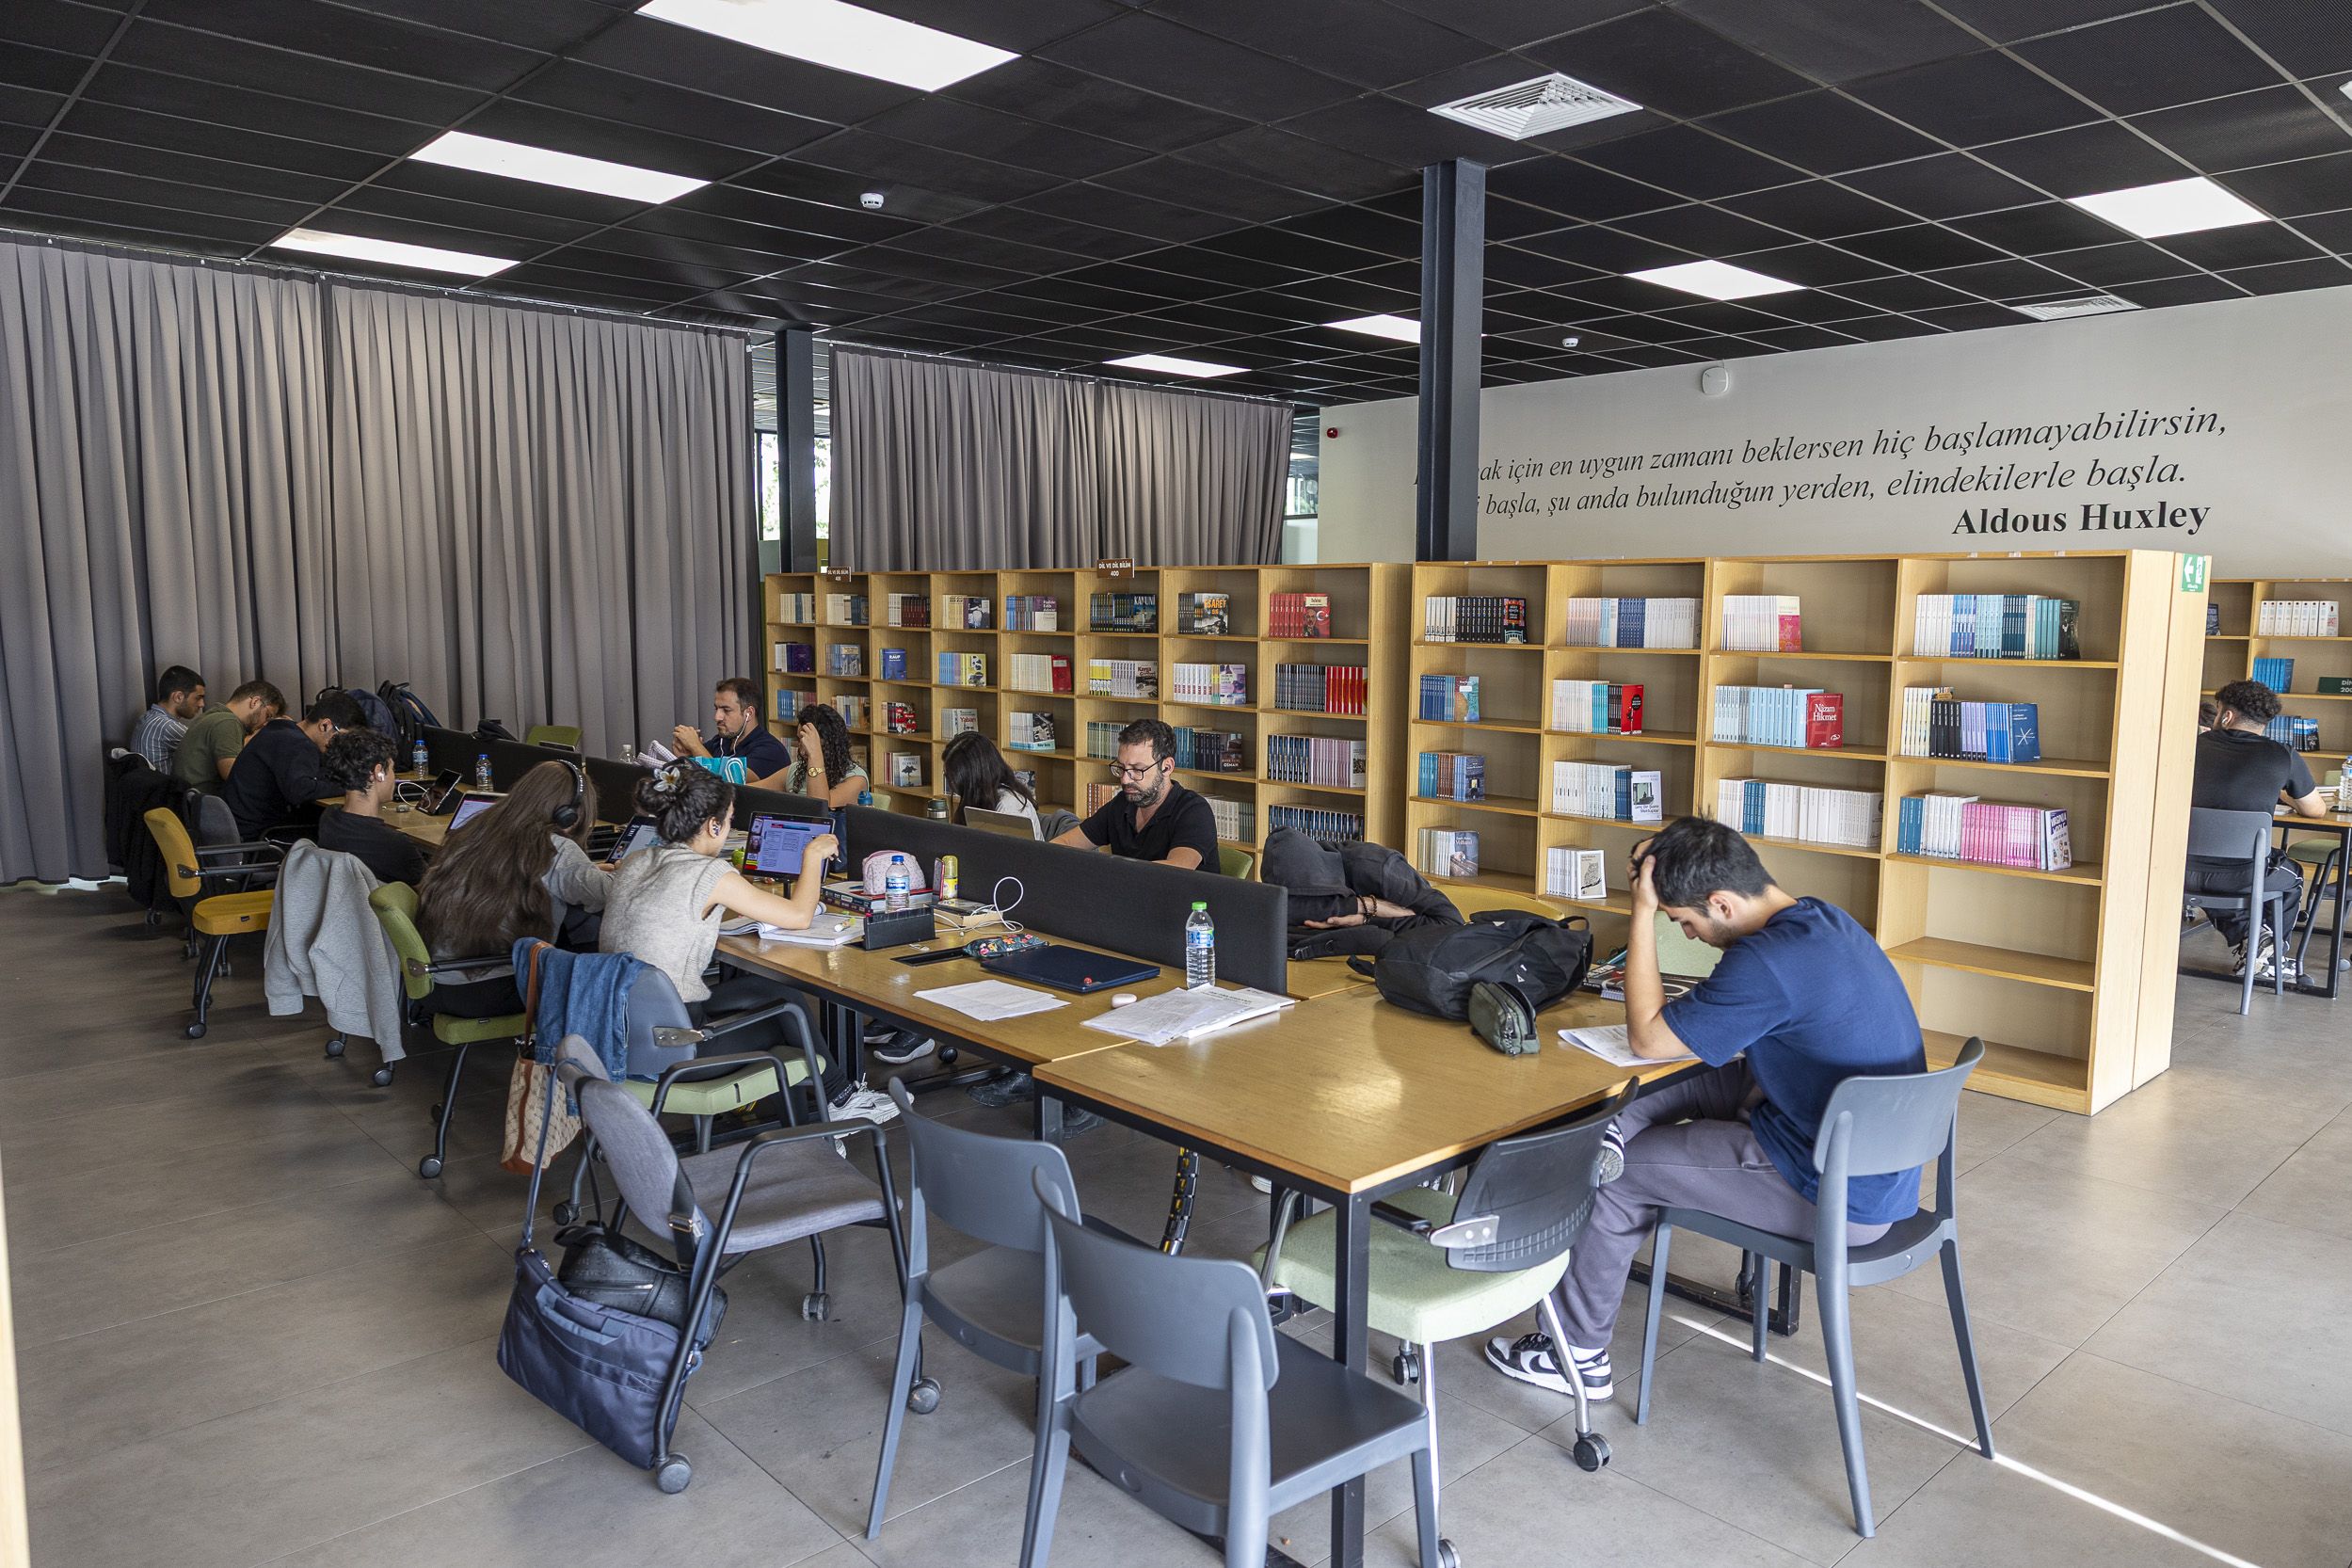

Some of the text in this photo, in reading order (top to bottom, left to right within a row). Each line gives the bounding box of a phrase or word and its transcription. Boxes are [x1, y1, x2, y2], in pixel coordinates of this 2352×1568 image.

[1479, 406, 2226, 485] ak için en uygun zamanı beklersen hiç başlamayabilirsin,
[1485, 491, 1541, 520] başla,
[1547, 496, 1571, 518] şu
[1577, 486, 1630, 510] anda
[1636, 480, 1774, 510] bulunduğun
[1778, 472, 1875, 508] yerden,
[1887, 460, 2076, 496] elindekilerle
[2086, 454, 2185, 492] başla.
[1951, 501, 2212, 536] Aldous Huxley
[1813, 712, 1837, 722] Hikmet
